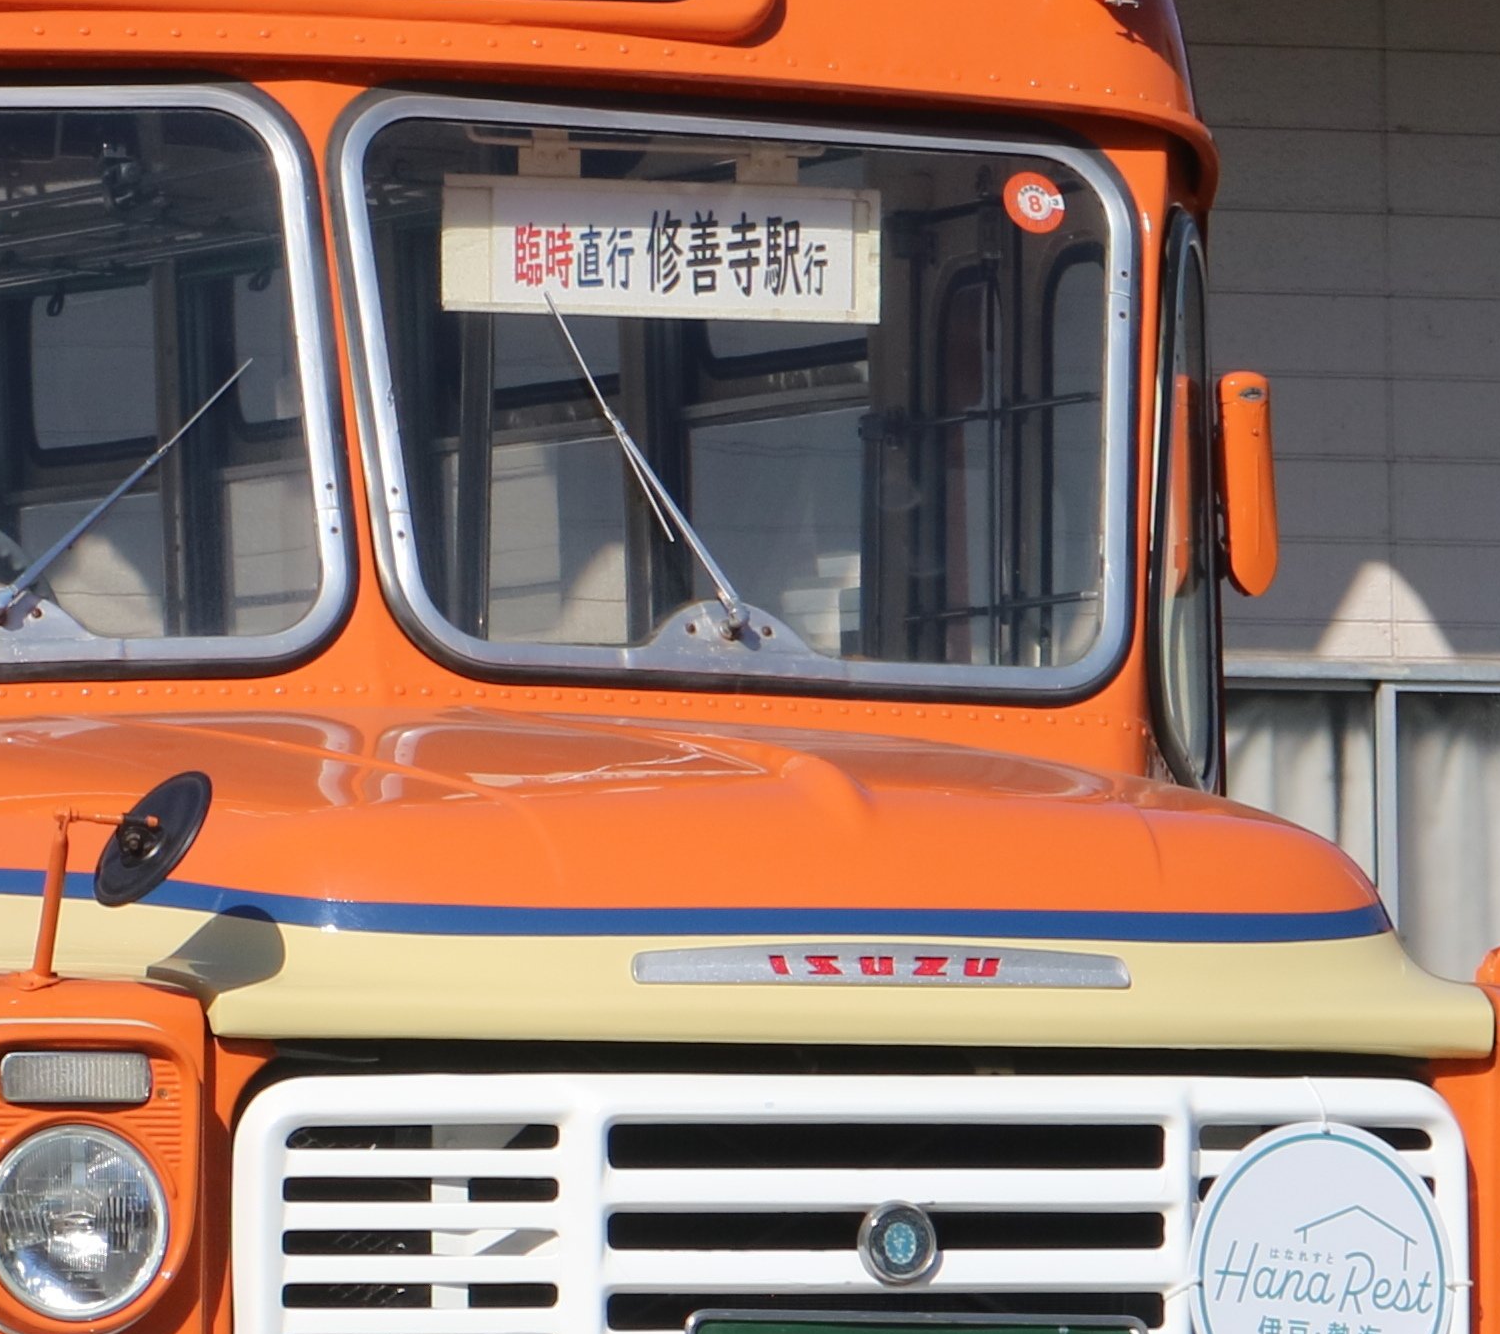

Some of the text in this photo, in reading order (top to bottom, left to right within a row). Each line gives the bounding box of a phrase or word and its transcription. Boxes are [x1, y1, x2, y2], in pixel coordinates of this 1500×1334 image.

[1028, 194, 1043, 213] 8
[513, 209, 829, 298] 臨時直行 修善寺駅行
[768, 954, 1002, 978] ISUZU
[1269, 1246, 1335, 1265] はなれすと
[1214, 1240, 1434, 1315] Hana Rest
